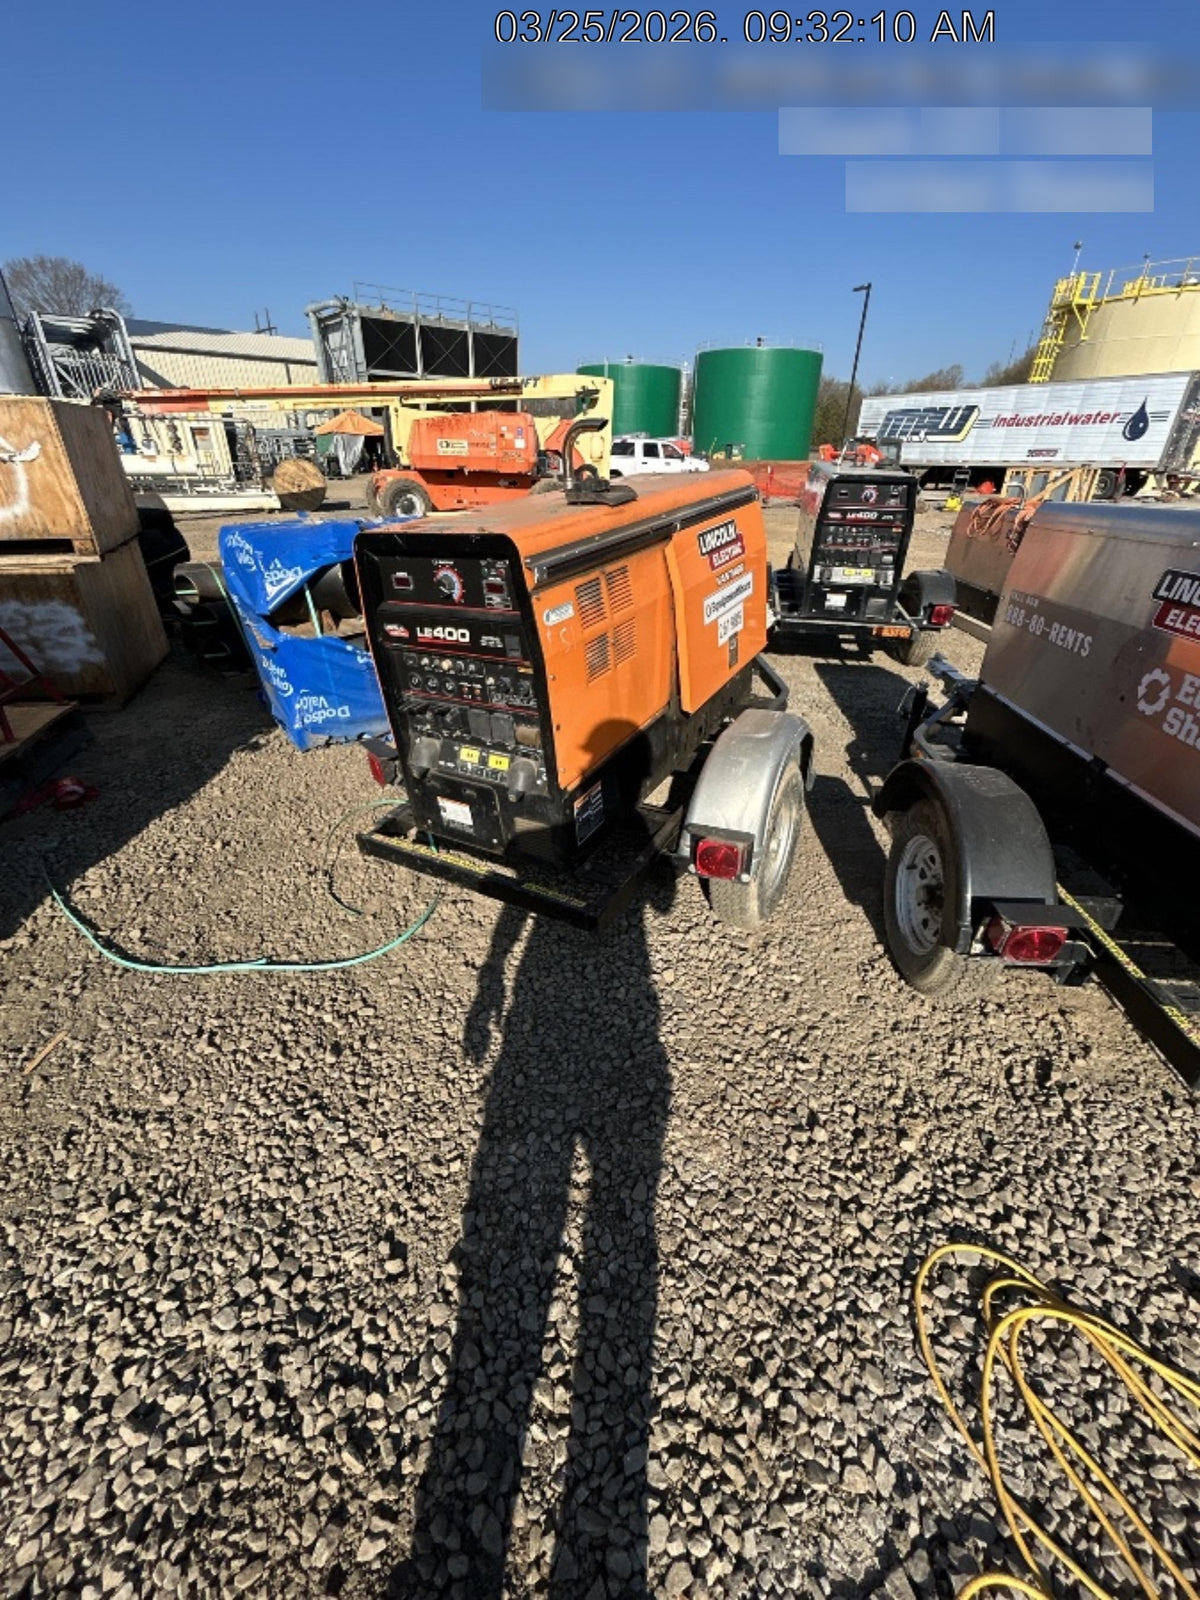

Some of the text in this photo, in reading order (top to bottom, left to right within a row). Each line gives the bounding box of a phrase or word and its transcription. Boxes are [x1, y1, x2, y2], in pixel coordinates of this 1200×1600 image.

[699, 522, 737, 554] LINCOLN
[416, 625, 470, 643] LE400
[1006, 604, 1093, 657] 888-80-RENTS
